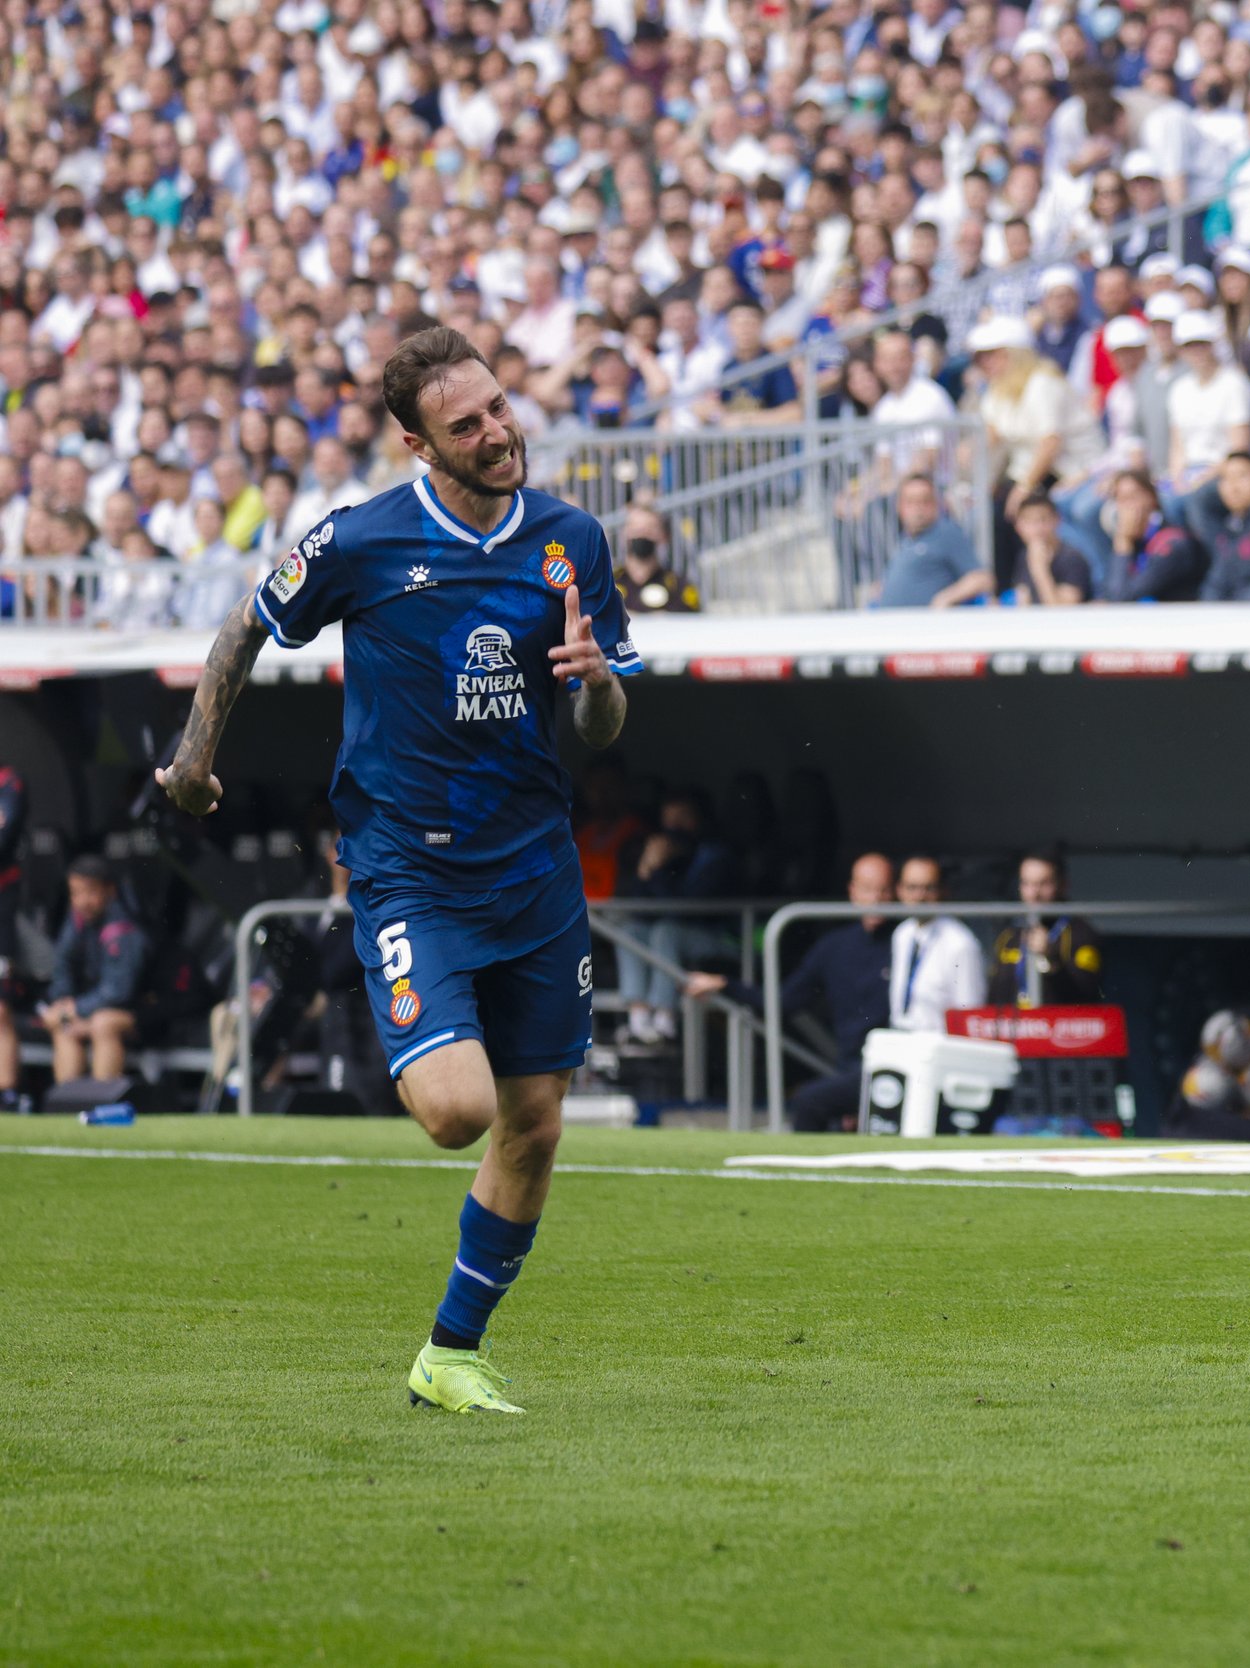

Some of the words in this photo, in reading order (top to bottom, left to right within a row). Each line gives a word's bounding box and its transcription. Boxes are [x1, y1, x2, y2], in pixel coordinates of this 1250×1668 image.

[404, 580, 439, 592] KELME
[619, 641, 635, 653] SE
[456, 673, 526, 694] RIVIERA
[455, 692, 528, 722] MAYA
[377, 921, 413, 981] 5
